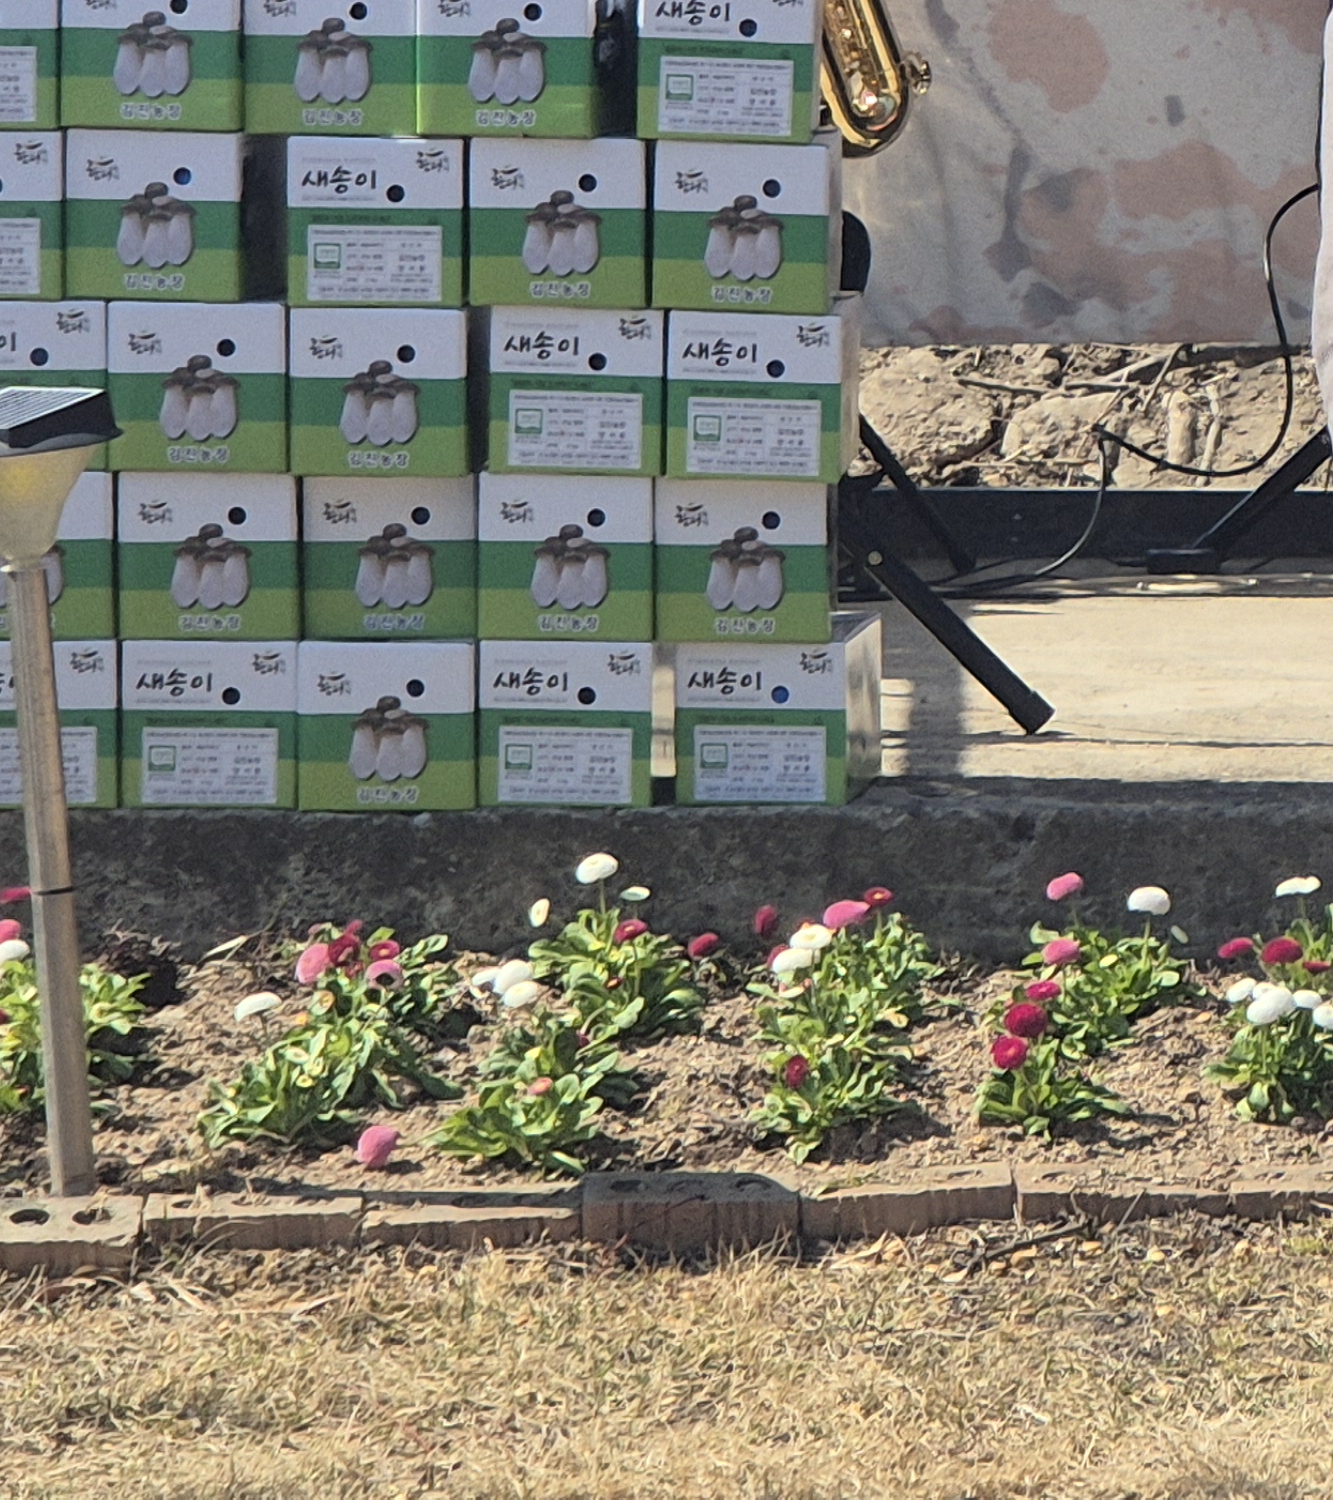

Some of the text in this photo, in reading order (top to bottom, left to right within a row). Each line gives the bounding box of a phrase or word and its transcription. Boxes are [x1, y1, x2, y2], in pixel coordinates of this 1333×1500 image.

[301, 165, 377, 194] 새송이
[503, 331, 579, 360] 새송이
[682, 338, 758, 367] 새송이
[136, 668, 212, 697] 새송이
[493, 667, 569, 696] 새송이
[686, 667, 762, 696] 새송이
